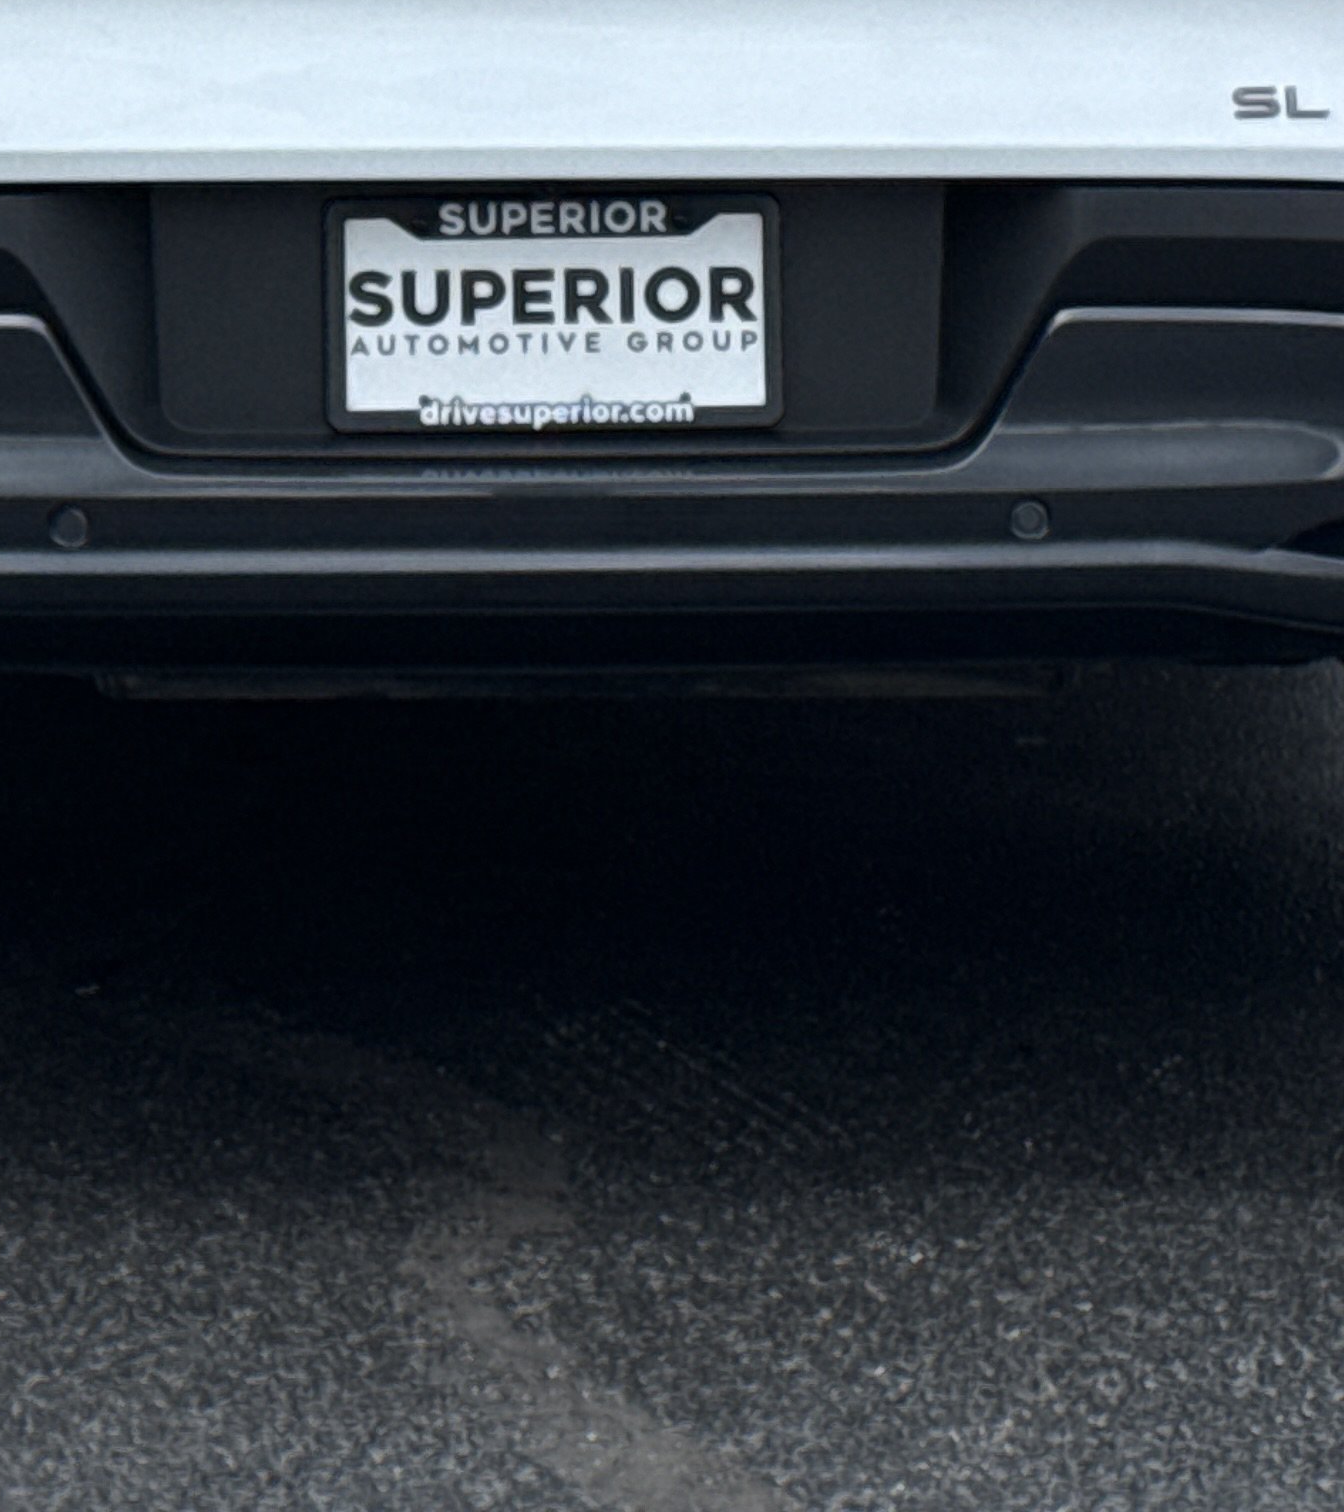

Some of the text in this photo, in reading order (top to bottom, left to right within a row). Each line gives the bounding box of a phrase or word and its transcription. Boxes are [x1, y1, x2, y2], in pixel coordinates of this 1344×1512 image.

[1231, 85, 1331, 120] SL
[438, 200, 668, 236] SUPERIOR
[348, 266, 758, 327] SUPERIOR
[350, 329, 759, 357] AUTOMOTIVE GROUP
[419, 396, 696, 431] drivesuperior.com
